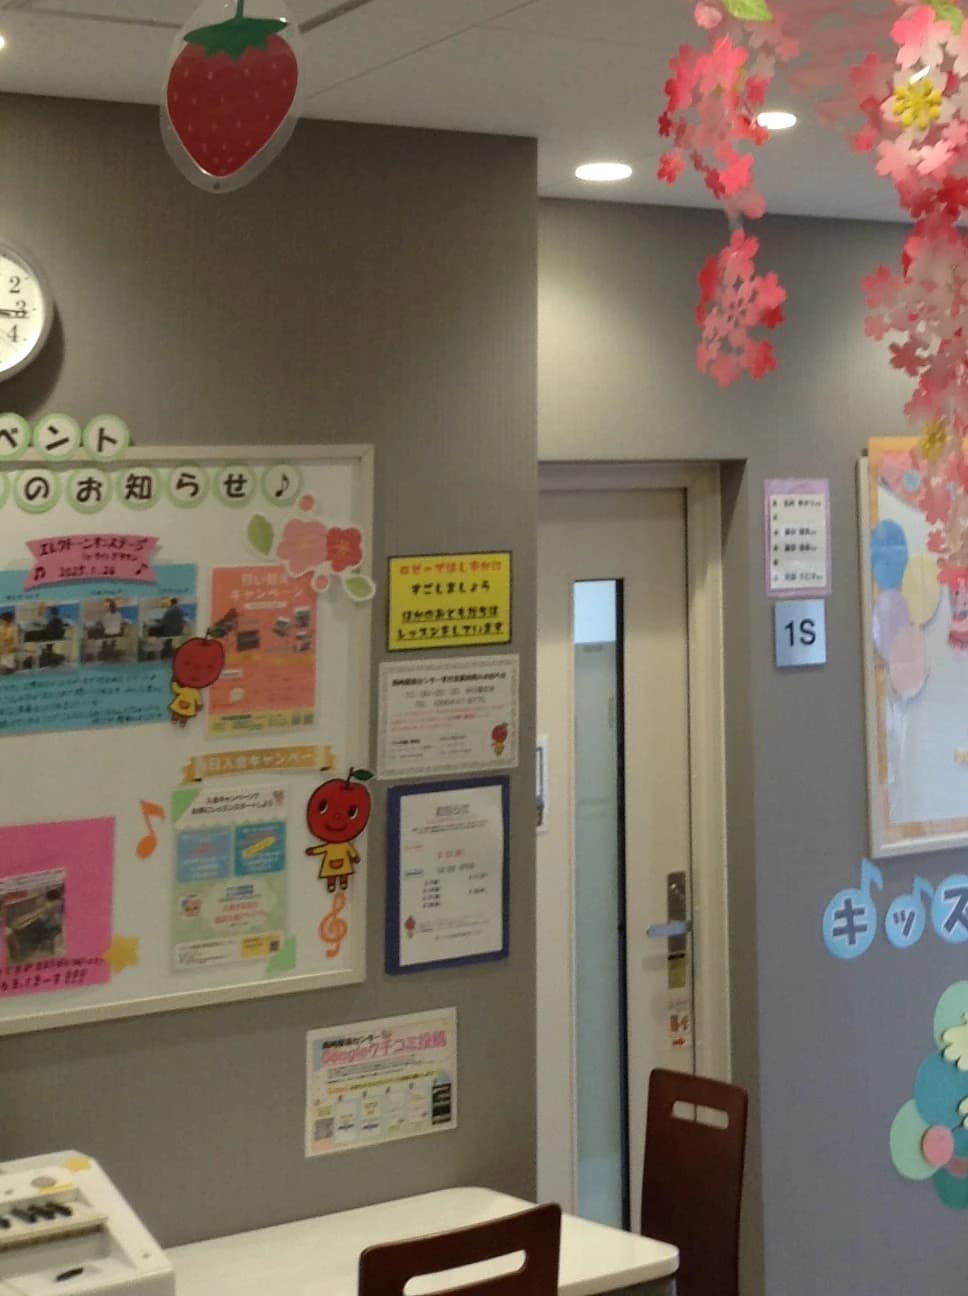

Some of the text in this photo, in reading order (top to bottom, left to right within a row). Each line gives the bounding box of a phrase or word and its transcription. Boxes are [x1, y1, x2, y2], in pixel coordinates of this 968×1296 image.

[9, 275, 21, 294] 2
[7, 325, 18, 343] 4
[411, 580, 490, 595] すごしましょう
[784, 618, 816, 647] 1S
